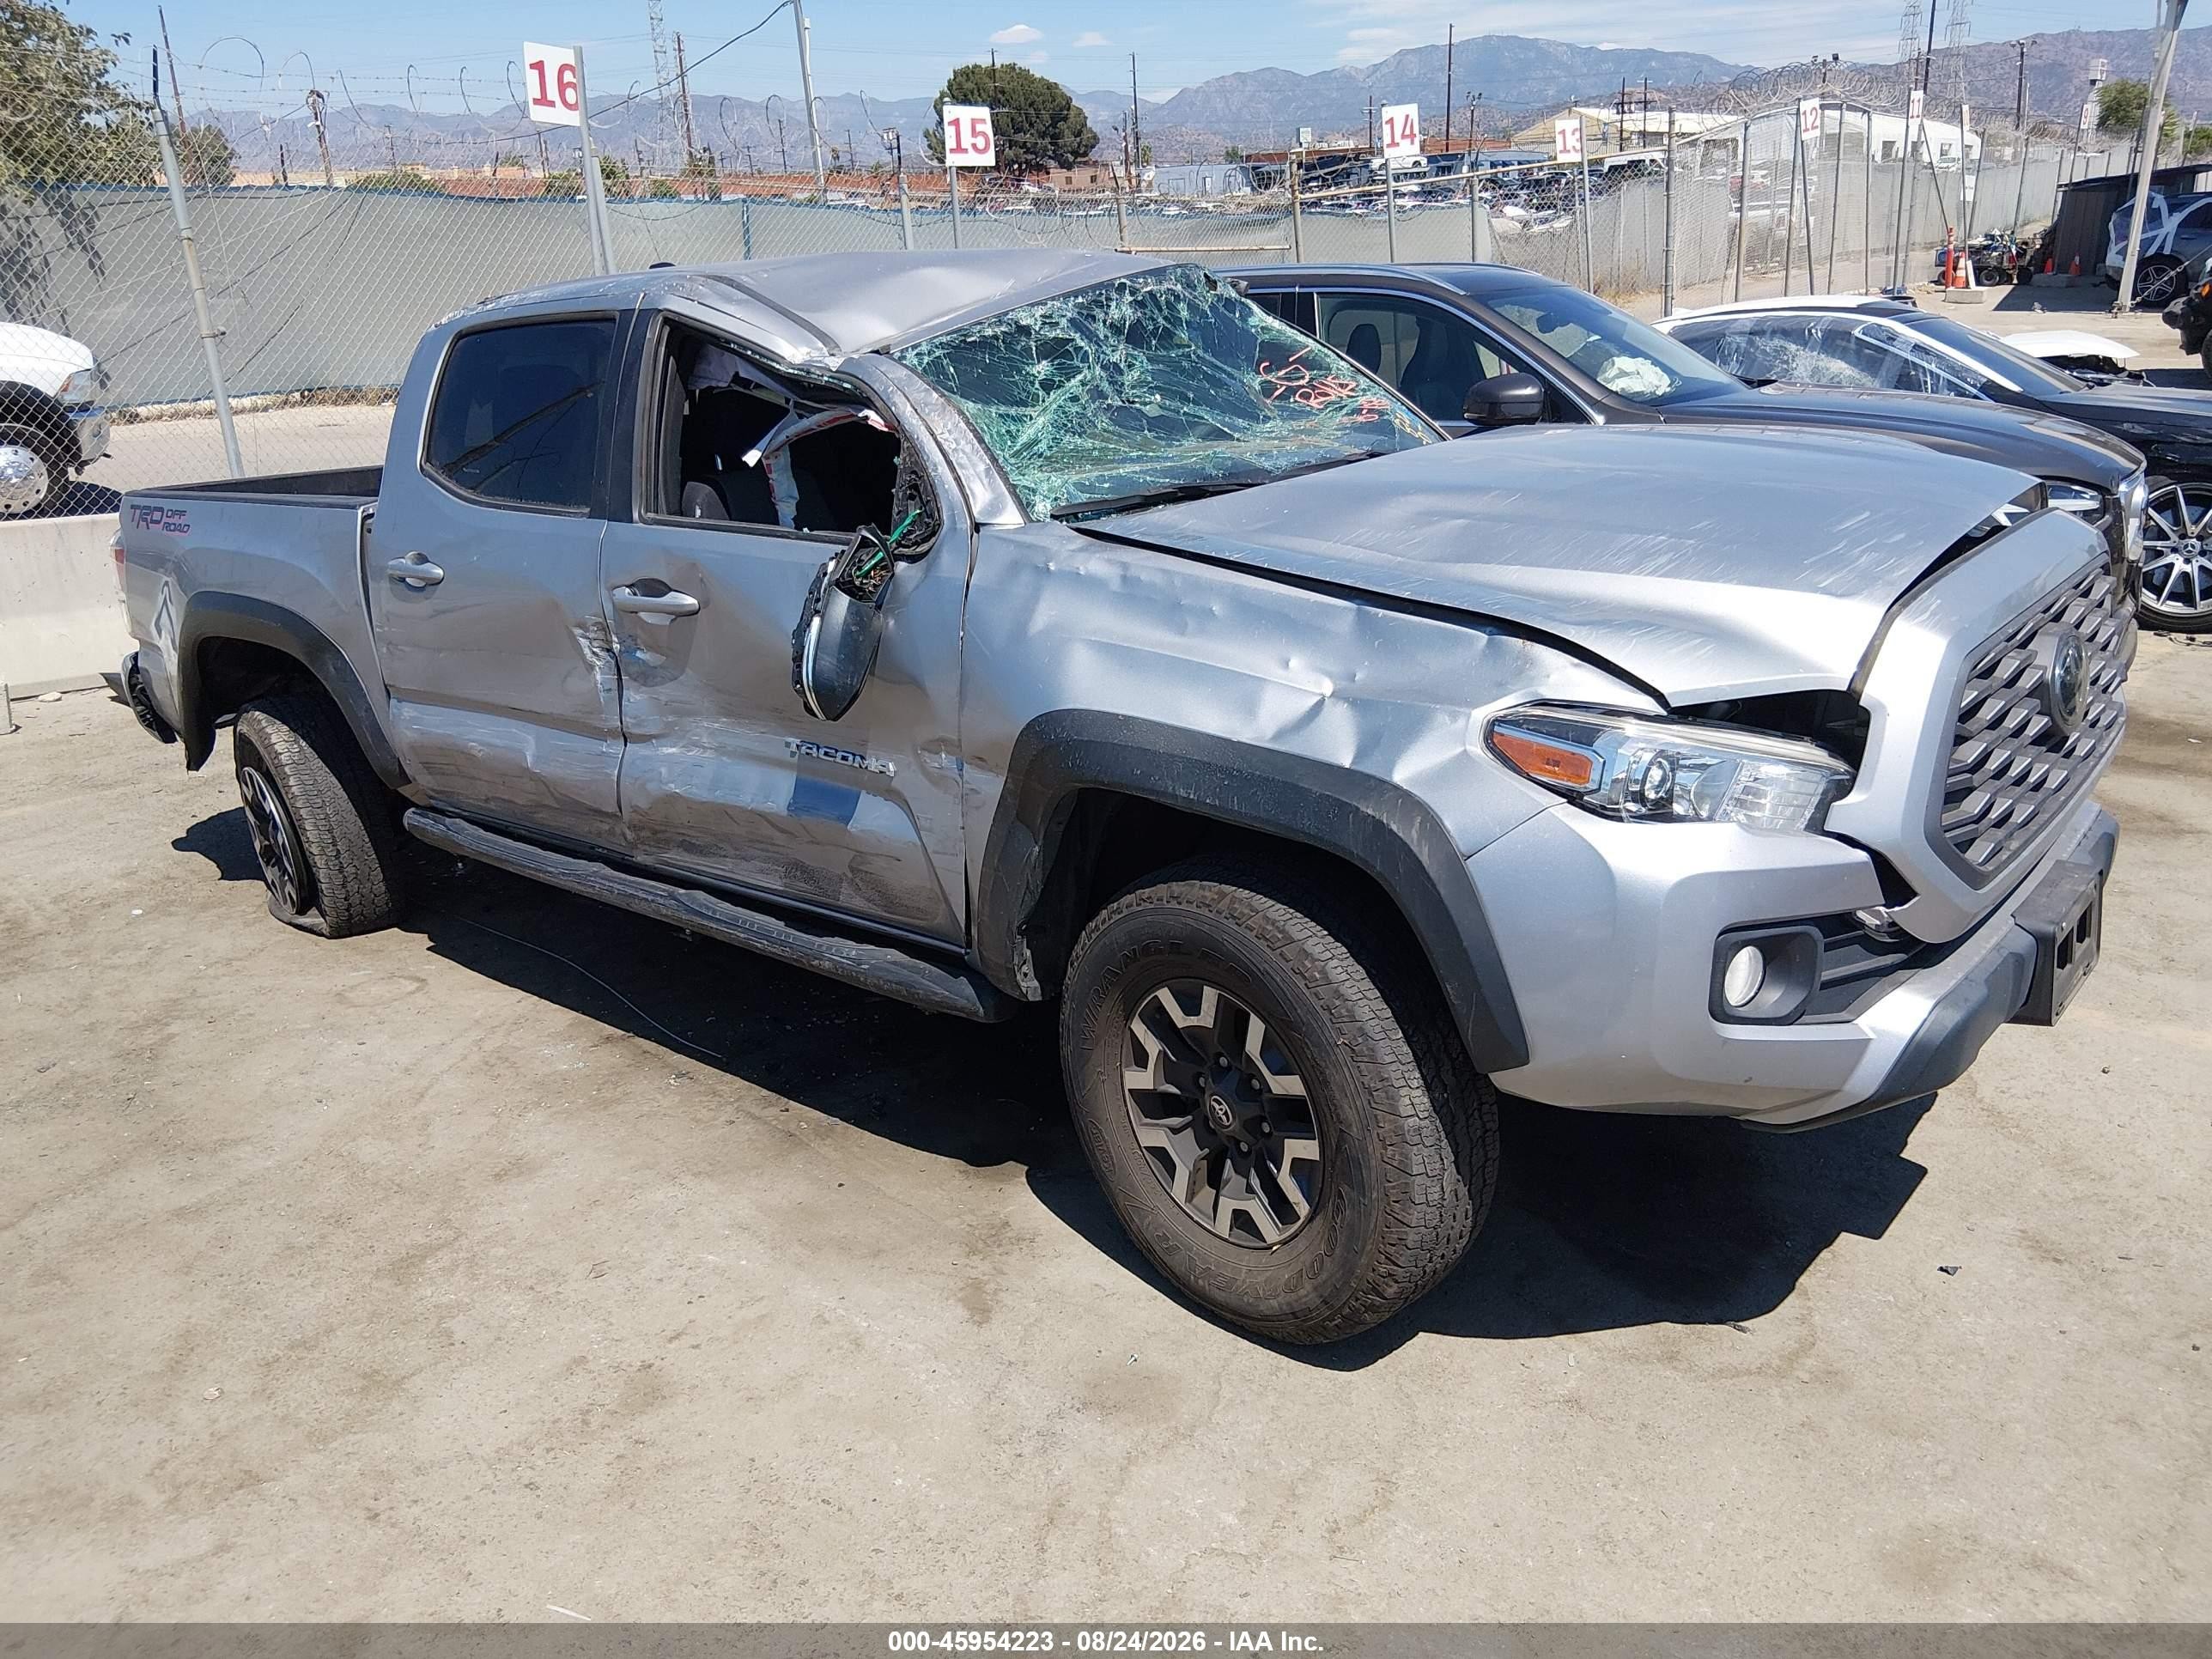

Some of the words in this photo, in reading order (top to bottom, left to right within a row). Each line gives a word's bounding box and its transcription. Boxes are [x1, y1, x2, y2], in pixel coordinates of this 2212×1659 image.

[529, 60, 579, 111] 16
[1802, 106, 1819, 133] 12
[1910, 98, 1920, 118] 11
[947, 117, 991, 155] 15
[1384, 113, 1416, 149] 14
[1558, 128, 1581, 154] 13
[131, 504, 165, 530] TRD
[165, 508, 187, 520] OFF
[161, 521, 191, 534] ROAD
[784, 738, 896, 777] TACOMA
